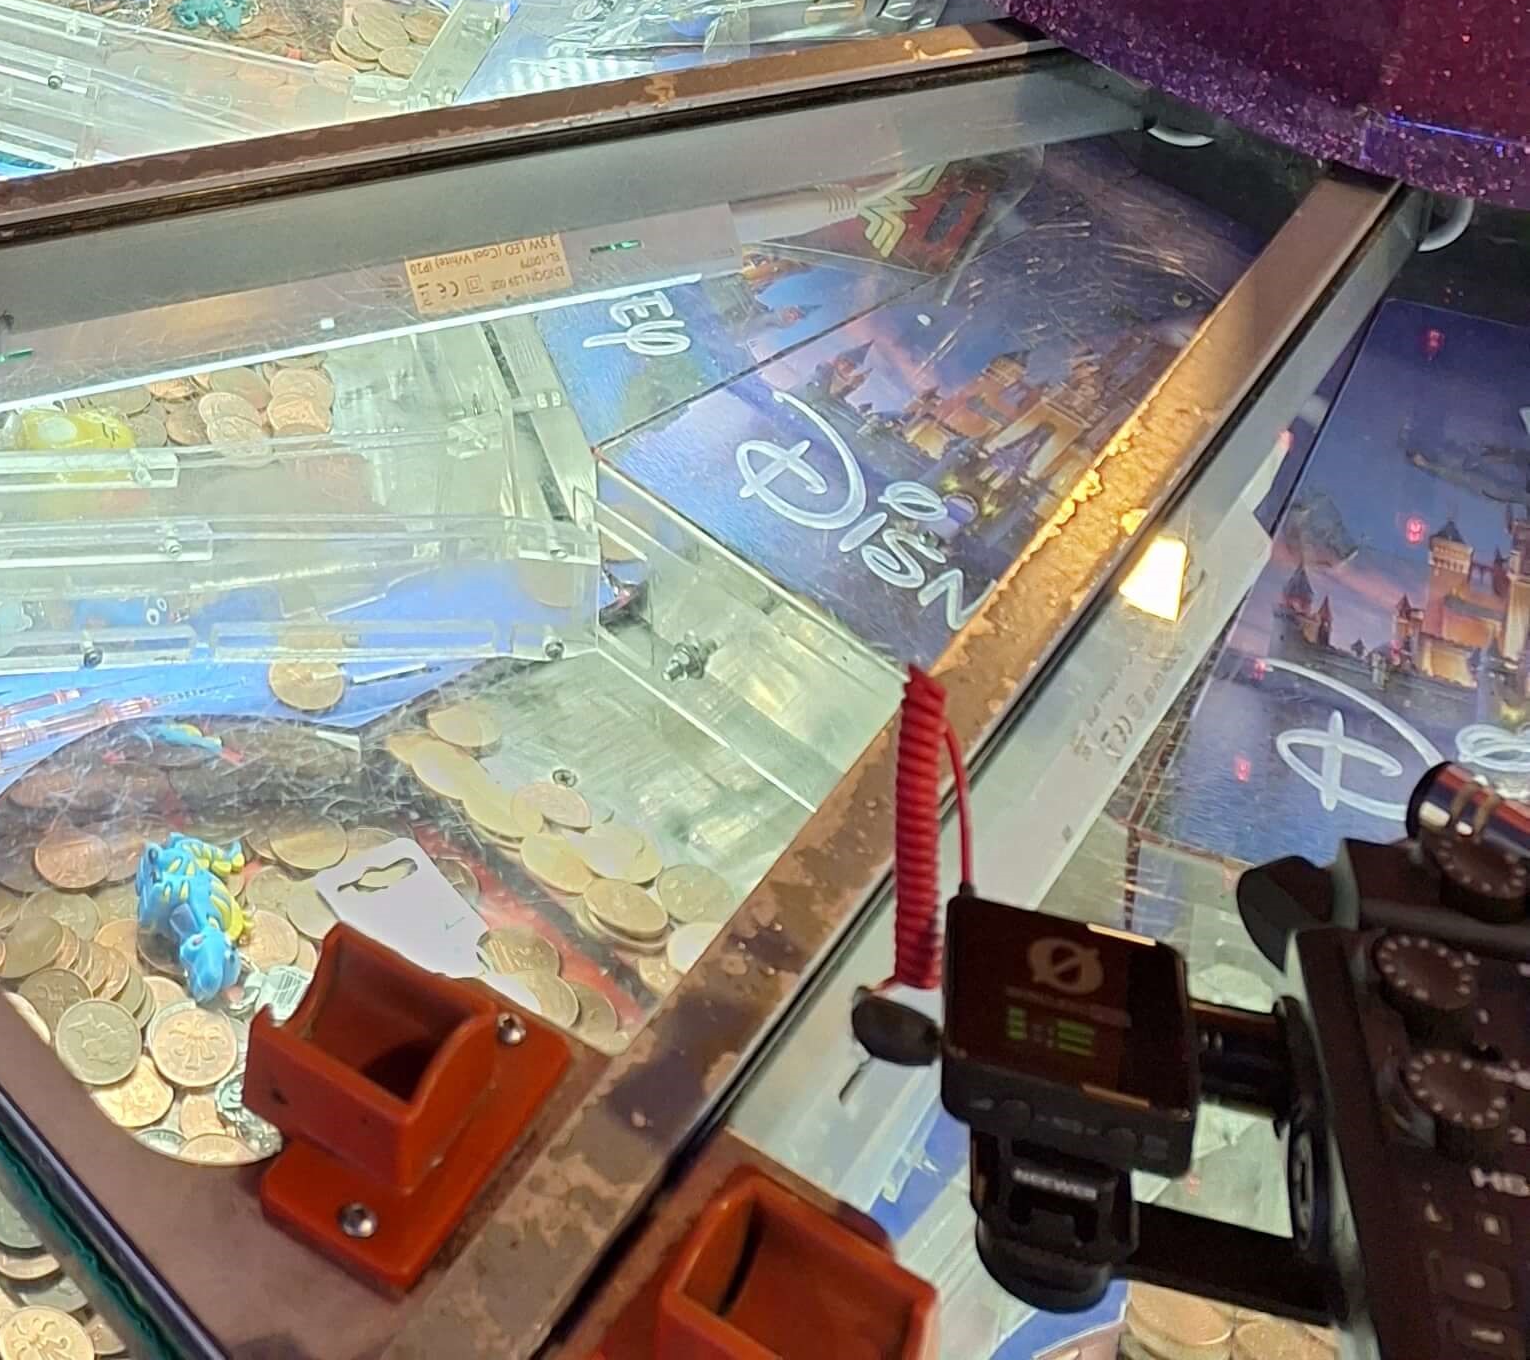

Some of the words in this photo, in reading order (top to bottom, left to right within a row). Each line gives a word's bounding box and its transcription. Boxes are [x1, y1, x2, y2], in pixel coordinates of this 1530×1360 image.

[474, 248, 502, 261] (Cool
[505, 243, 527, 256] LED
[436, 253, 472, 268] White)
